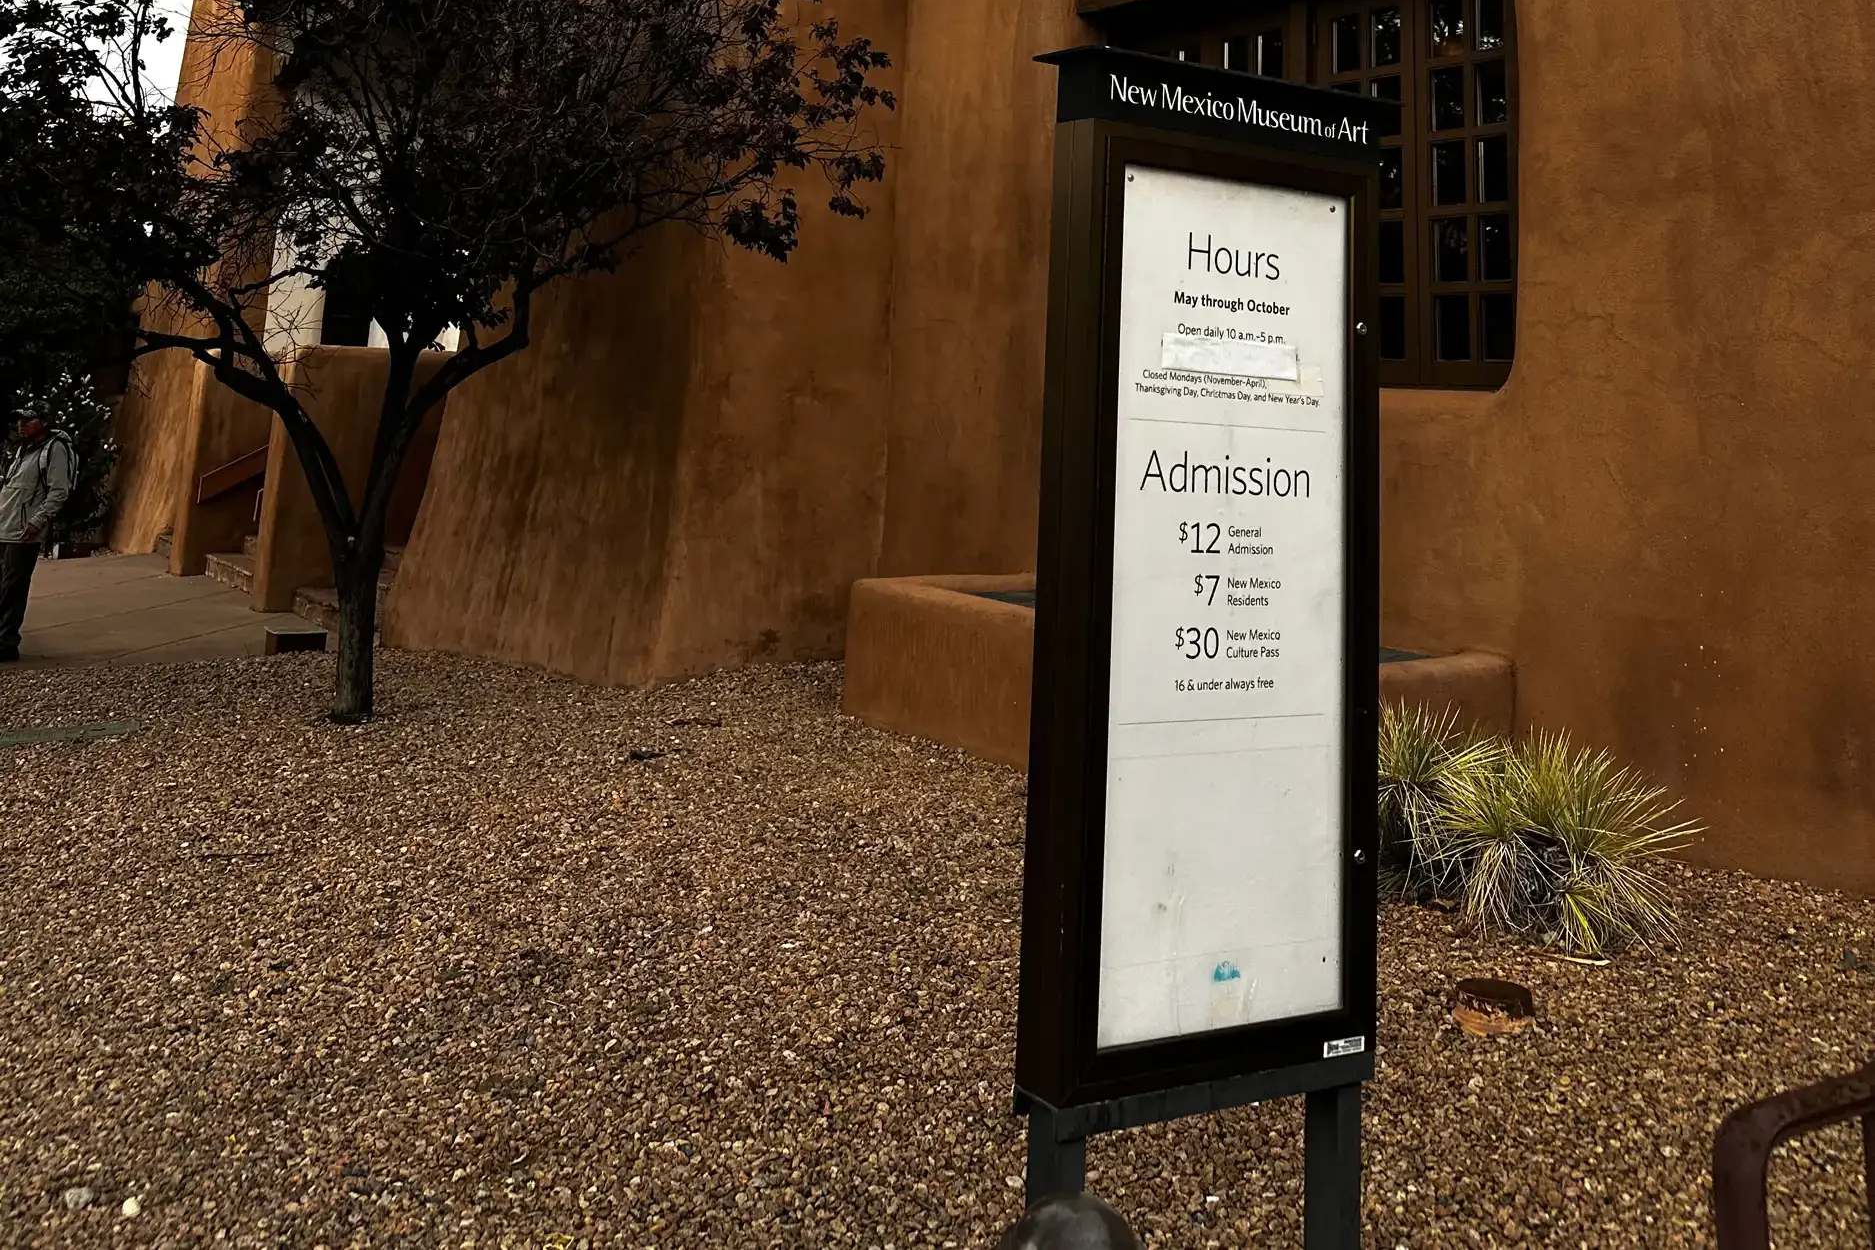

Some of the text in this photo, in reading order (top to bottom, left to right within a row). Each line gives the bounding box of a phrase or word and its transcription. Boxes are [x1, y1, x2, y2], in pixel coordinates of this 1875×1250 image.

[1109, 74, 1369, 144] New Mexico Museum of Art
[1188, 231, 1281, 280] Hours
[1174, 290, 1290, 315] May through October
[1177, 323, 1202, 336] Open
[1203, 326, 1224, 339] daily
[1226, 328, 1237, 340] 10
[1267, 333, 1286, 345] p.m.
[1142, 369, 1168, 381] Closed
[1169, 371, 1202, 385] Mondays
[1135, 383, 1182, 397] Thanksgiving
[1183, 387, 1199, 398] Day,
[1200, 388, 1236, 401] Christmas
[1253, 393, 1267, 402] and
[1268, 394, 1284, 404] New
[1306, 396, 1321, 407] Day.
[1139, 449, 1311, 498] Admission
[1178, 521, 1221, 554] $12
[1228, 525, 1262, 538] General
[1227, 543, 1274, 555] Admission
[1194, 574, 1220, 606] $7
[1227, 577, 1282, 589] New Mexico
[1227, 594, 1269, 606] Residents
[1175, 626, 1220, 659] $30
[1226, 629, 1281, 641] New Mexico
[1226, 646, 1280, 659] Culture Pass
[1174, 677, 1274, 691] 16 & under always free
